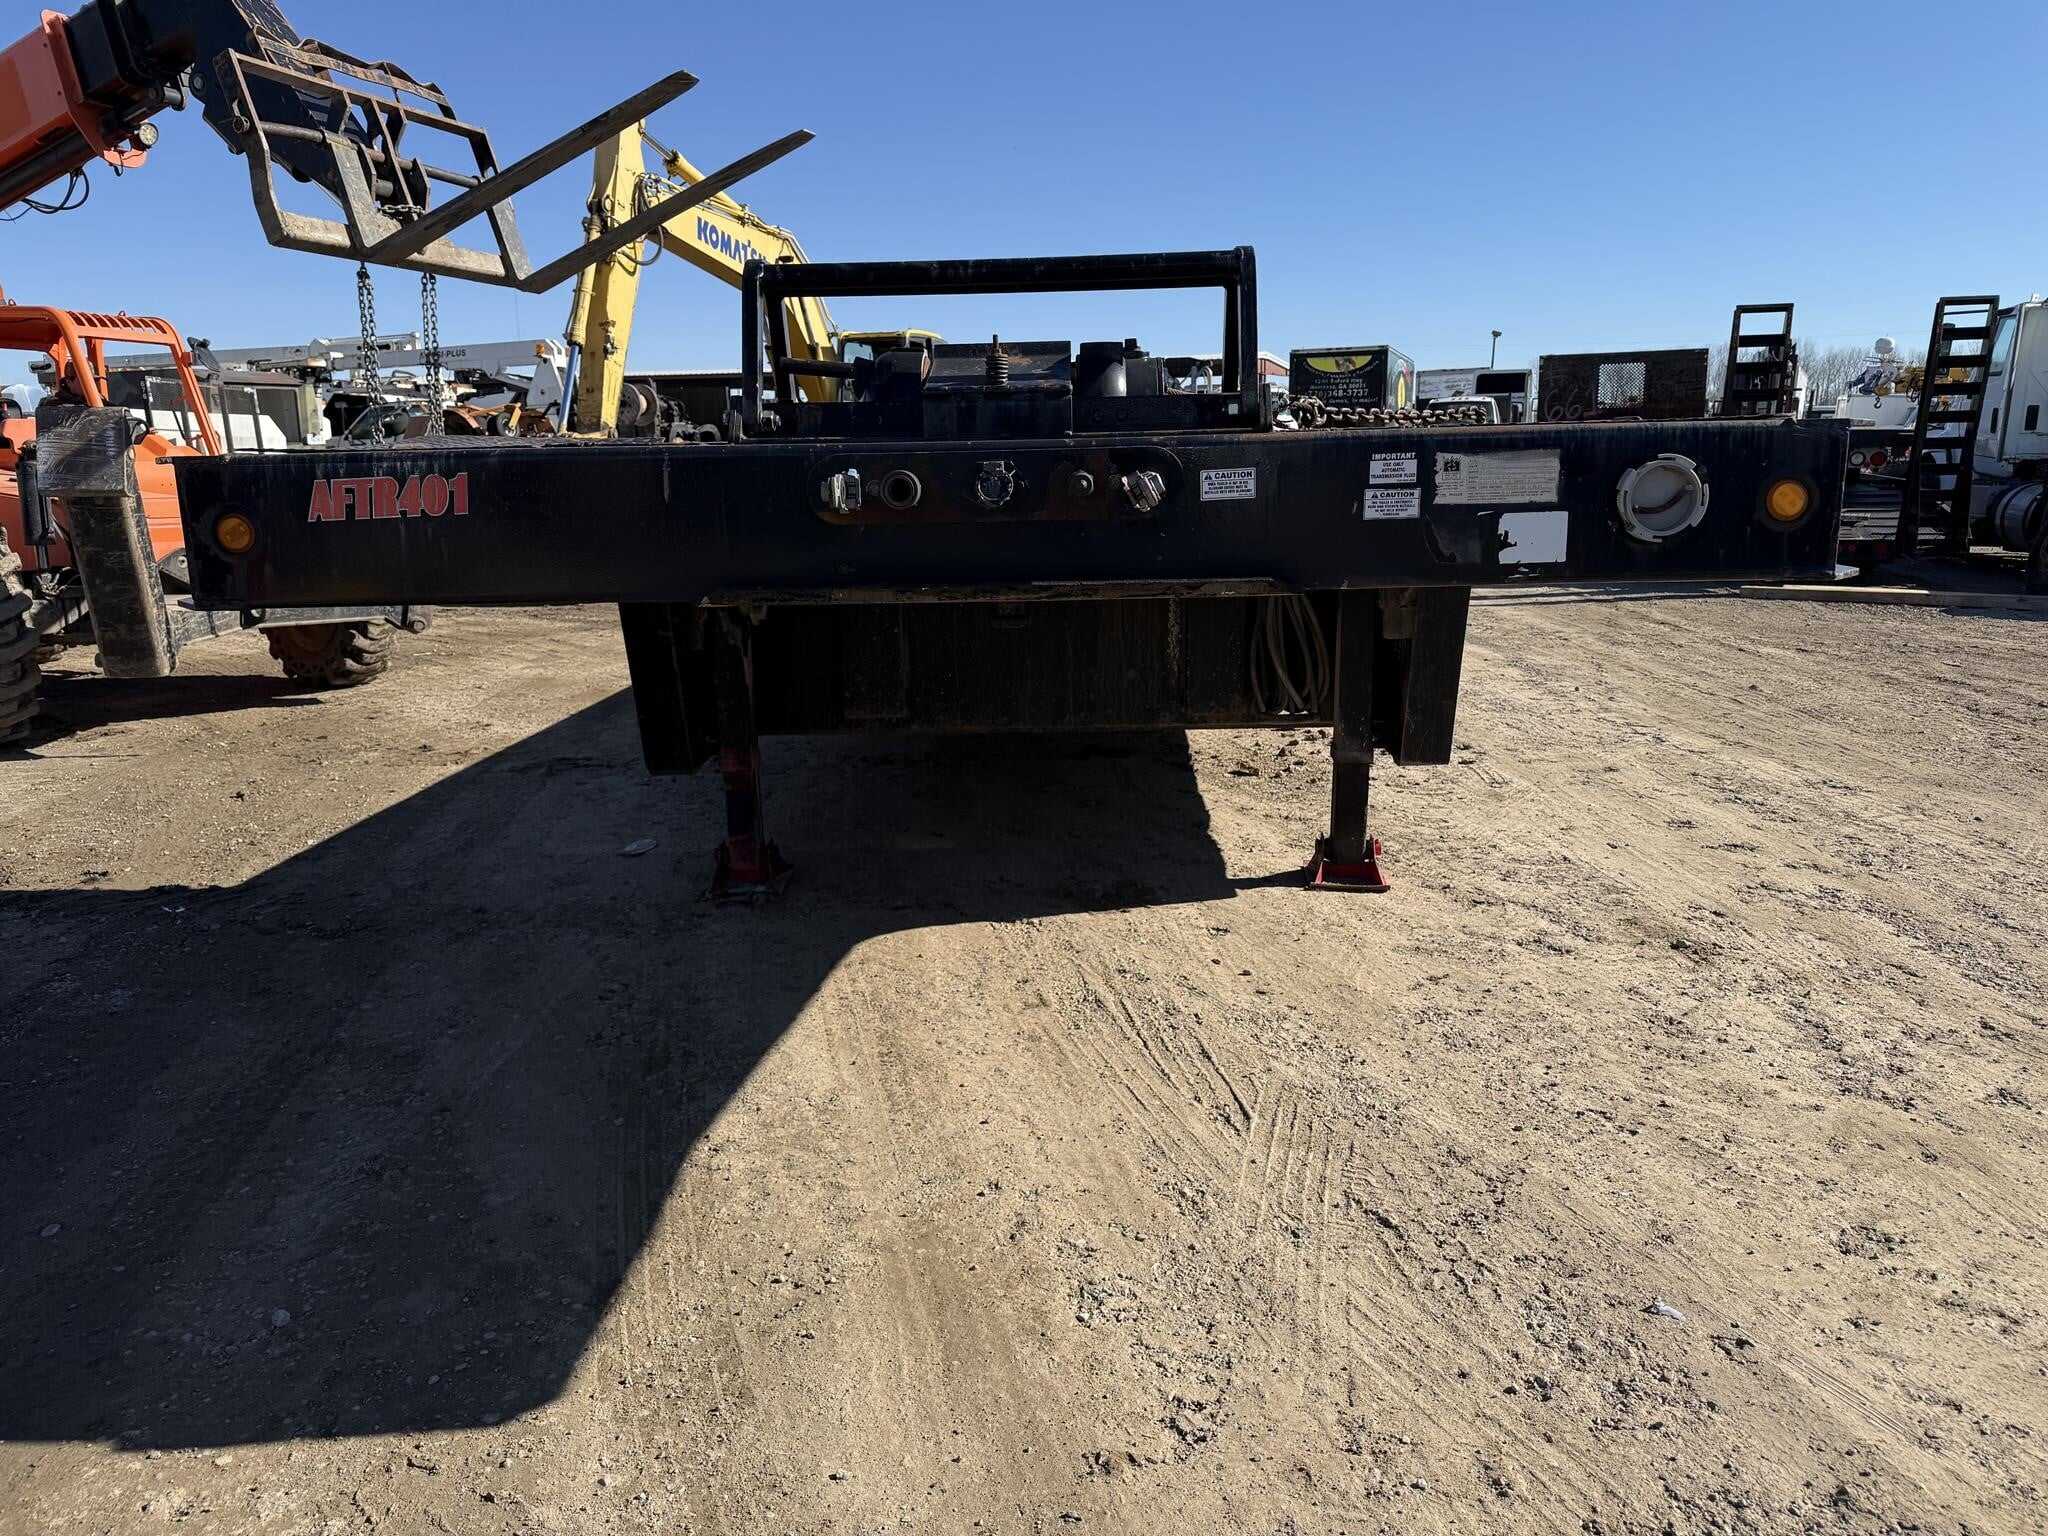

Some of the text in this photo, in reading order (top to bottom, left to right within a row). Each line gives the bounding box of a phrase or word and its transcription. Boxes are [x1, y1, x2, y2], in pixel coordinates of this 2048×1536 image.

[697, 216, 766, 264] KOMAT
[1372, 452, 1416, 460] IMPORTANT
[1214, 471, 1253, 480] CAUTION
[308, 472, 469, 522] AFTR401
